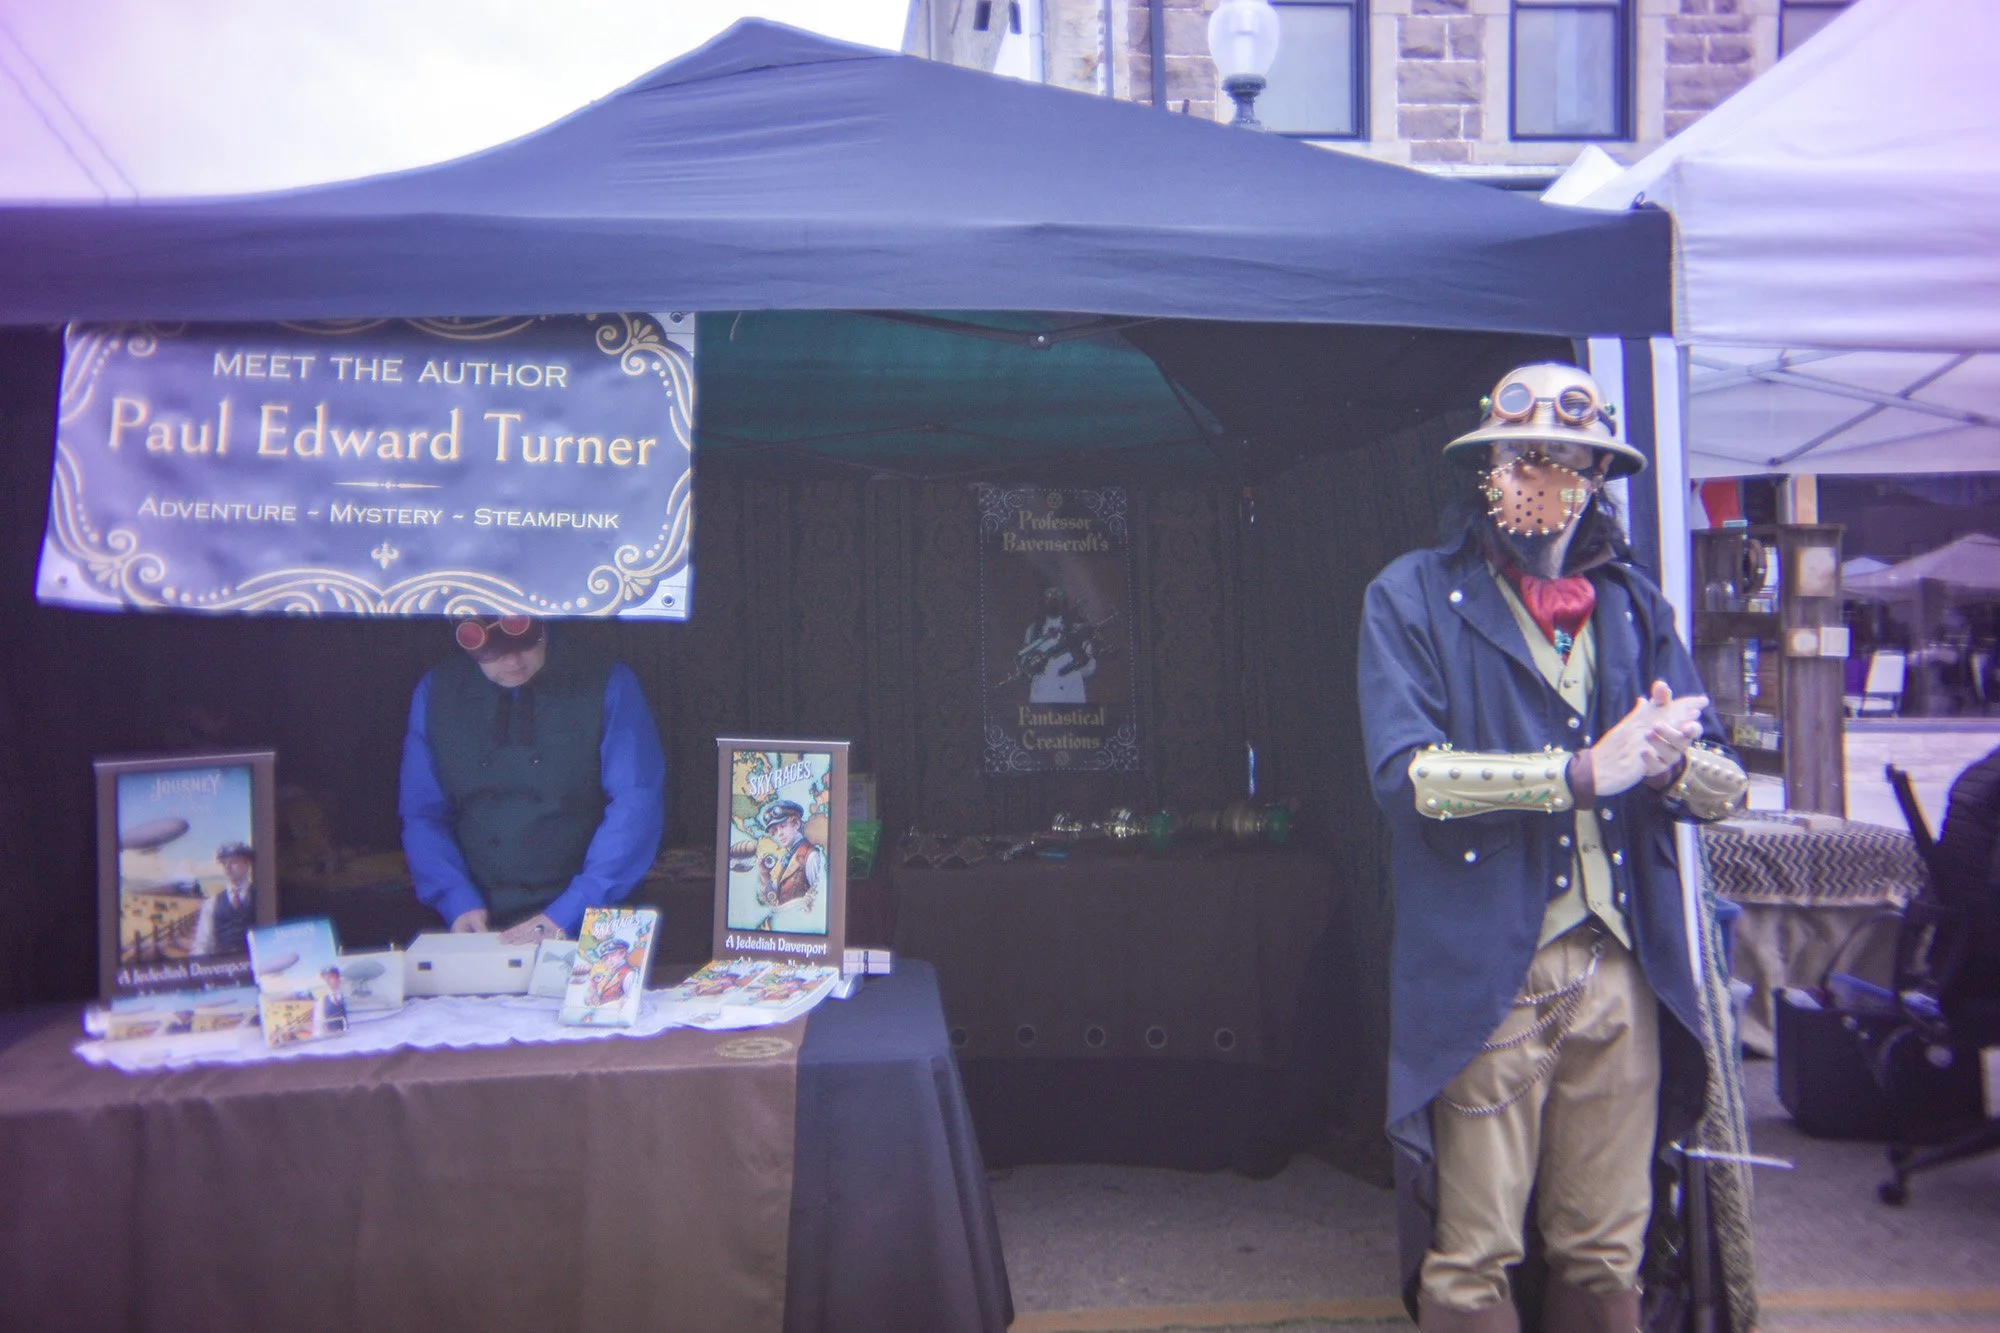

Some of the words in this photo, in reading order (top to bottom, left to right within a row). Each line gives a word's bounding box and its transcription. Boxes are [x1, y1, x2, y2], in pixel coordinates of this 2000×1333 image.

[213, 352, 315, 378] MEET
[330, 356, 403, 382] THE
[418, 360, 567, 388] AUTHOR
[108, 396, 229, 453] Paul
[257, 402, 460, 461] Edward
[484, 411, 657, 466] Turner
[138, 498, 297, 521] ADVENTURE
[330, 503, 443, 525] MYSTERY
[474, 507, 620, 529] STEAMPUNK
[1018, 510, 1092, 531] Professor
[1002, 532, 1109, 553] Ravenscroft's
[1018, 706, 1104, 726] Fantastical
[1023, 729, 1100, 750] Creations
[749, 771, 773, 797] SKY
[774, 760, 812, 790] RACES
[725, 935, 734, 948] A
[736, 936, 776, 951] Jedediah
[777, 938, 827, 958] Davenport
